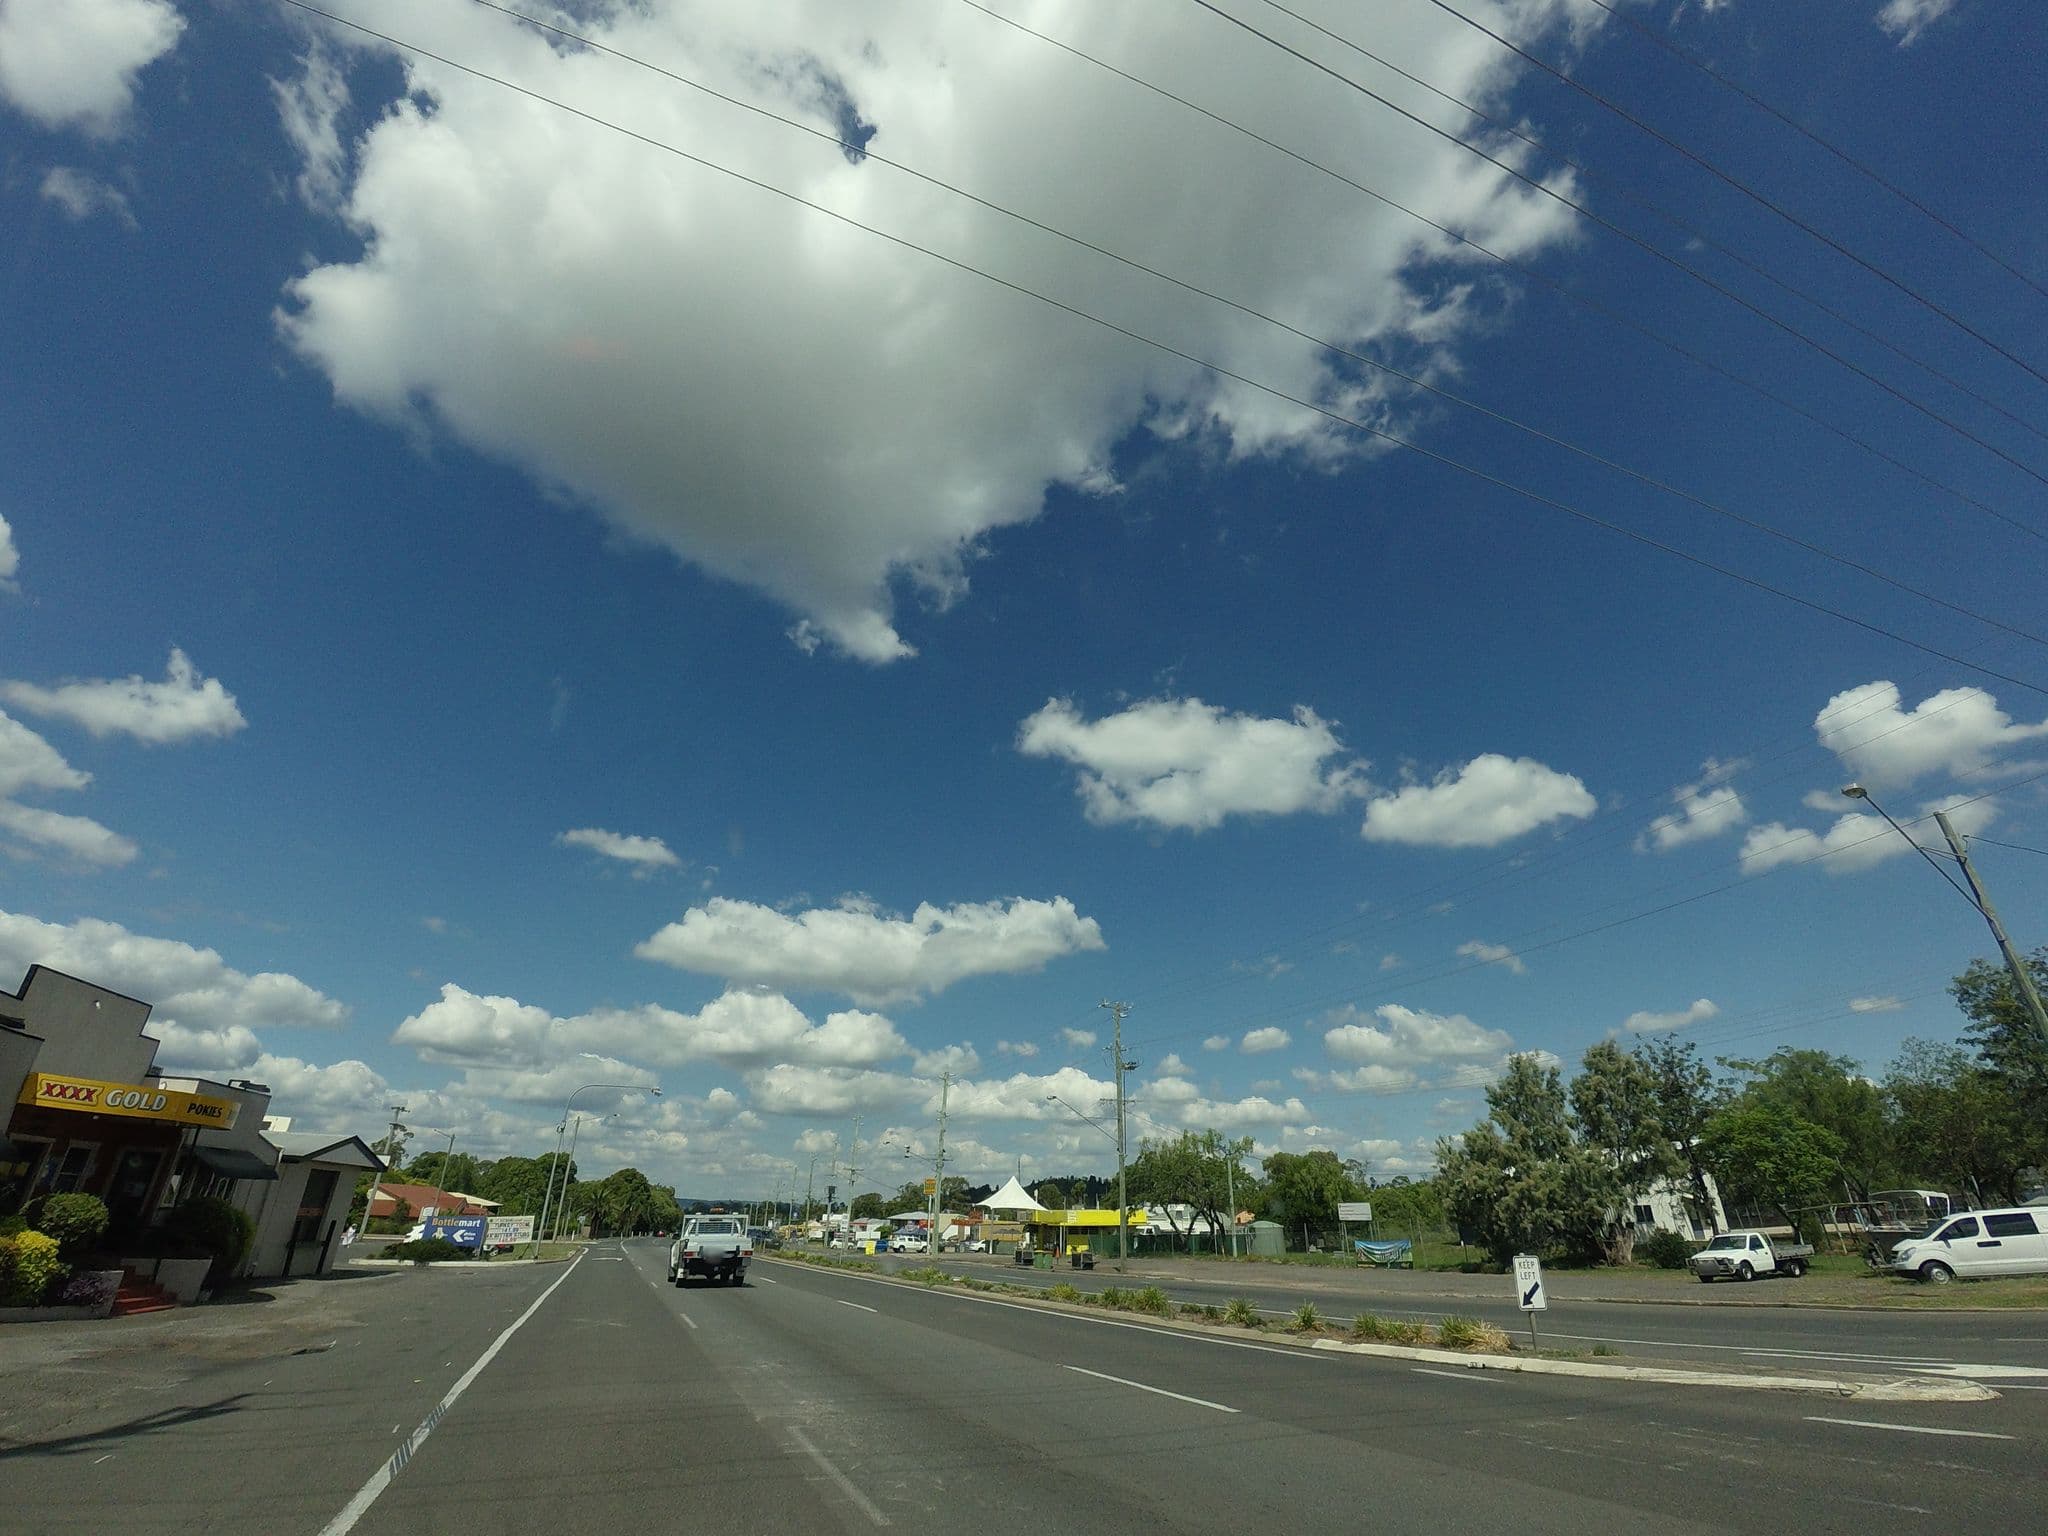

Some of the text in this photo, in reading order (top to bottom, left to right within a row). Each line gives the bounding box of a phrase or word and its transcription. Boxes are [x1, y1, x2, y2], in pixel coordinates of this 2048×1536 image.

[41, 1083, 223, 1118] XXXX GOLD POKIES
[432, 1218, 481, 1227] Bottlemart
[1518, 1261, 1535, 1269] KEEP
[1520, 1271, 1536, 1280] LEFT
